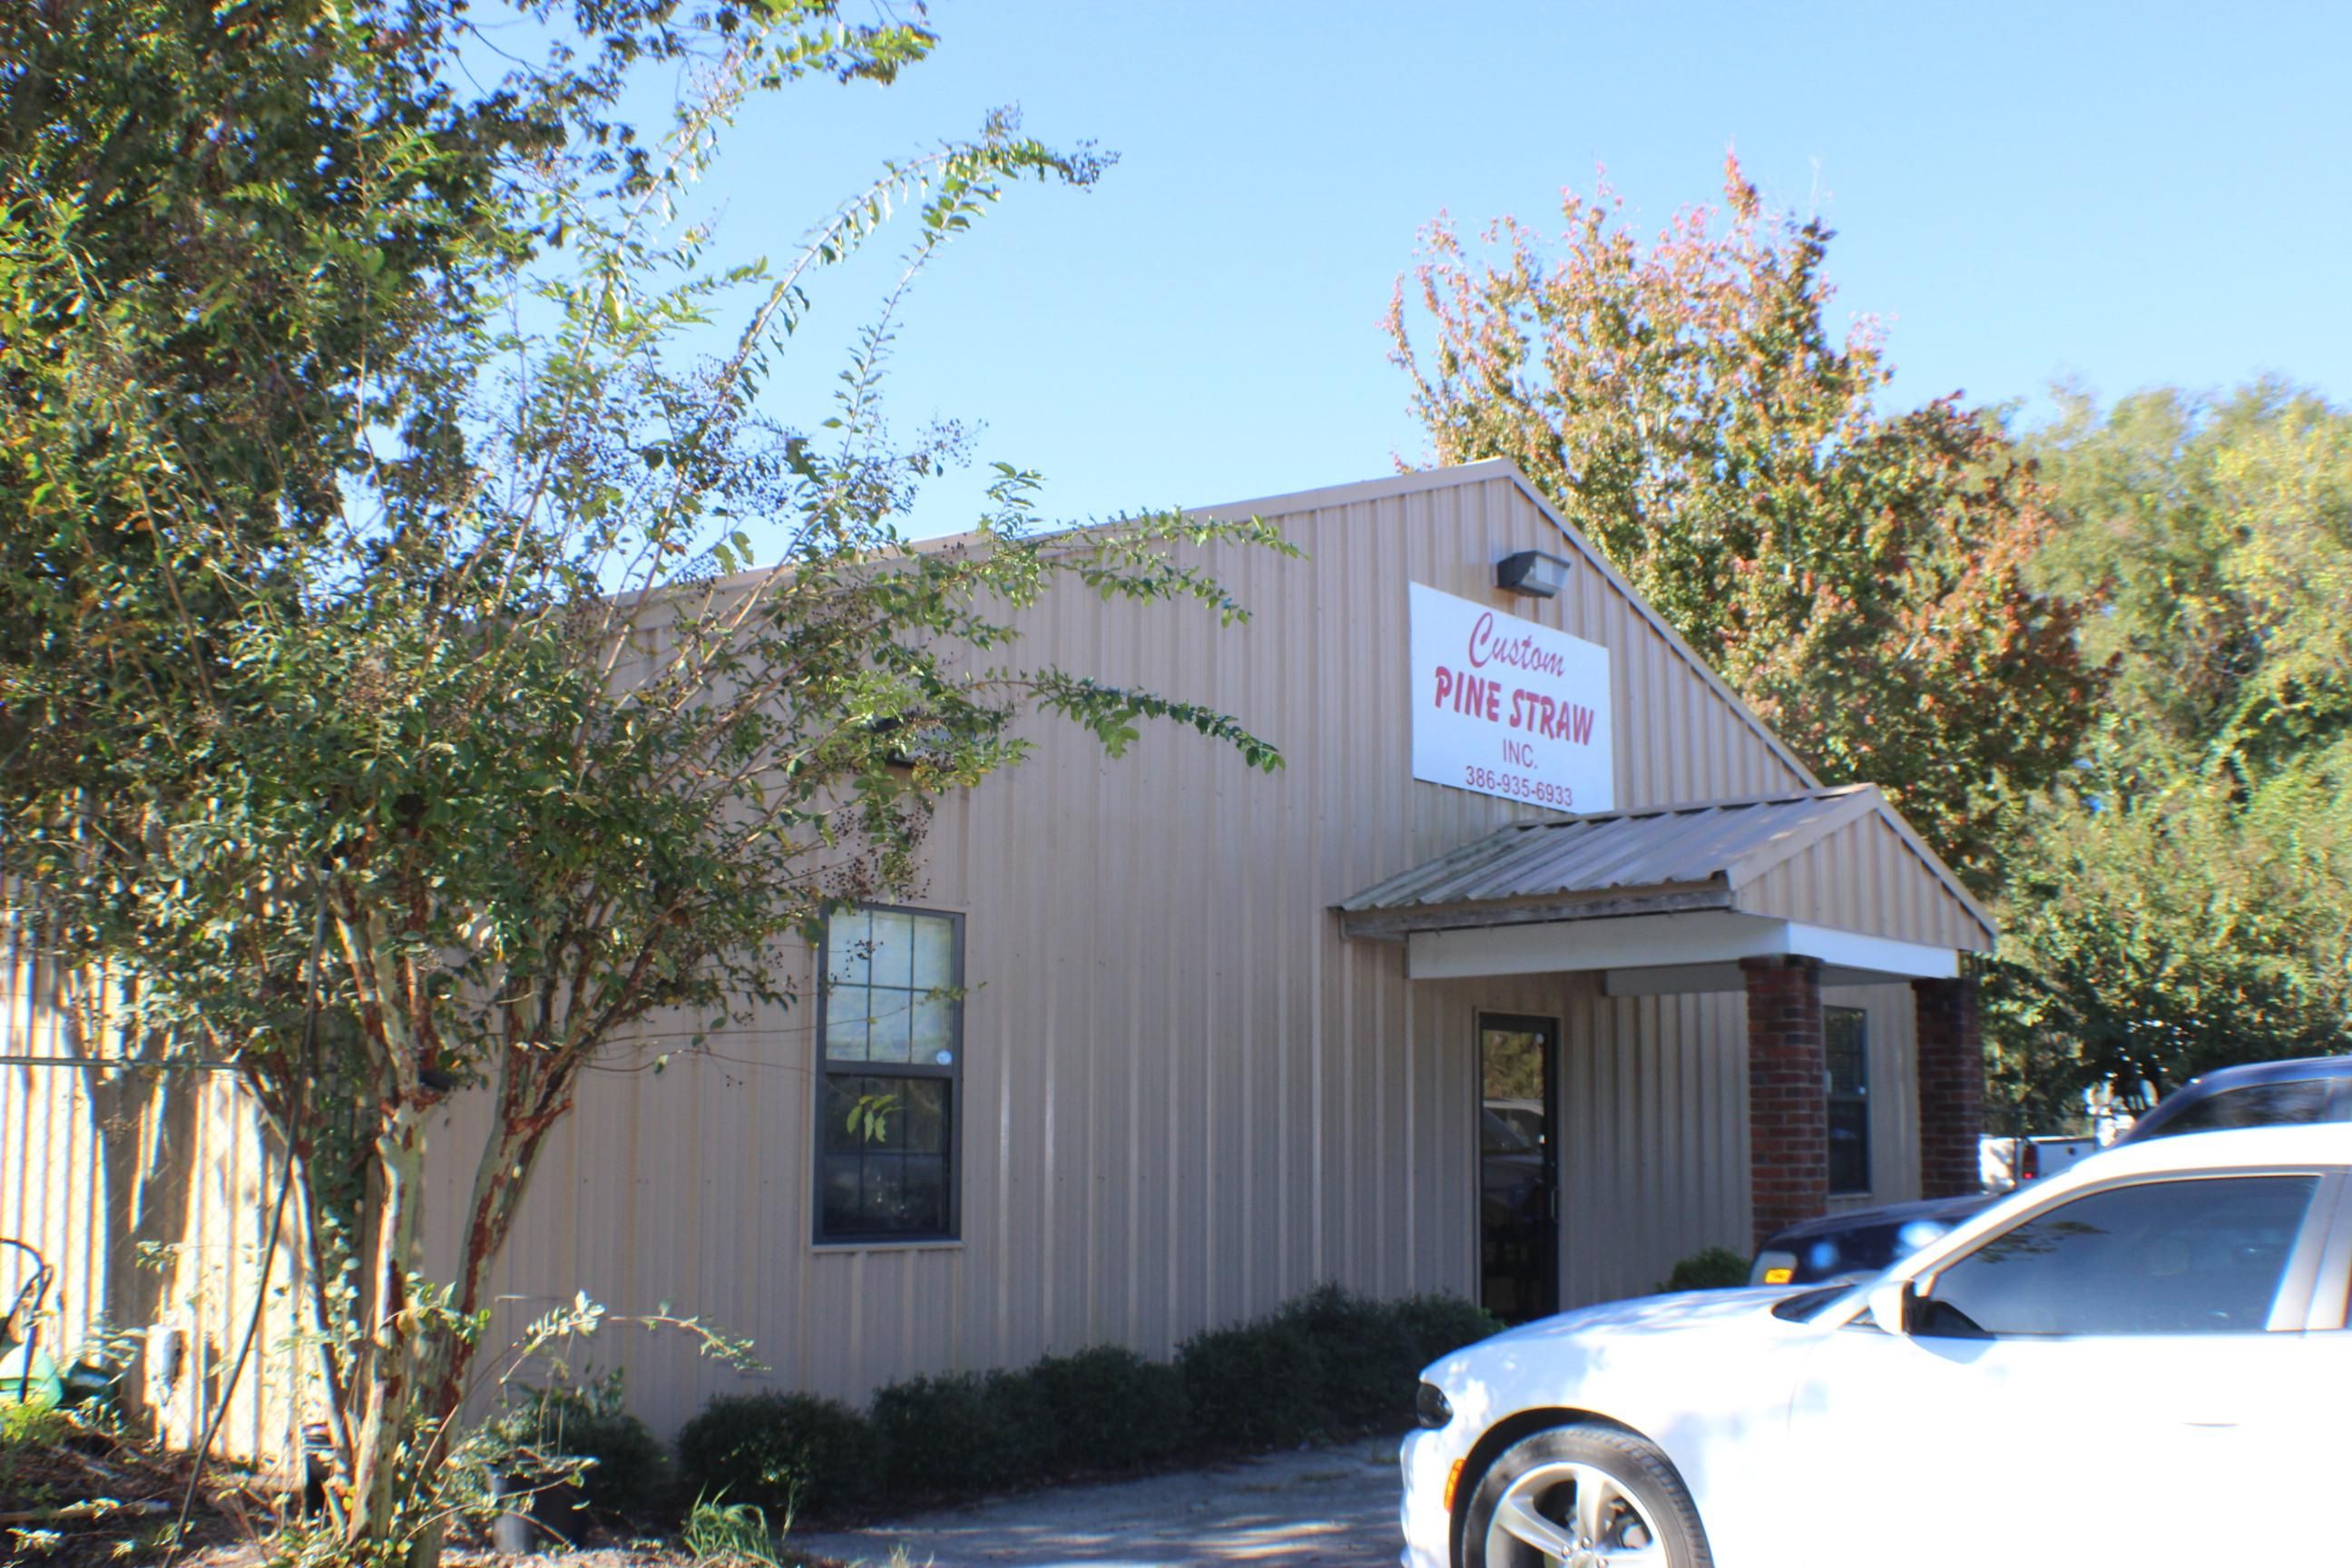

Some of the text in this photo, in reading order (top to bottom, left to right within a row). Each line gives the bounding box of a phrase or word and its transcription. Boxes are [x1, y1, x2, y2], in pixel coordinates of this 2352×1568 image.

[1468, 612, 1565, 677] Custom
[1435, 666, 1594, 746] PINE STRAW
[1503, 739, 1538, 769] INC.
[1465, 765, 1573, 807] 386-935-6933
